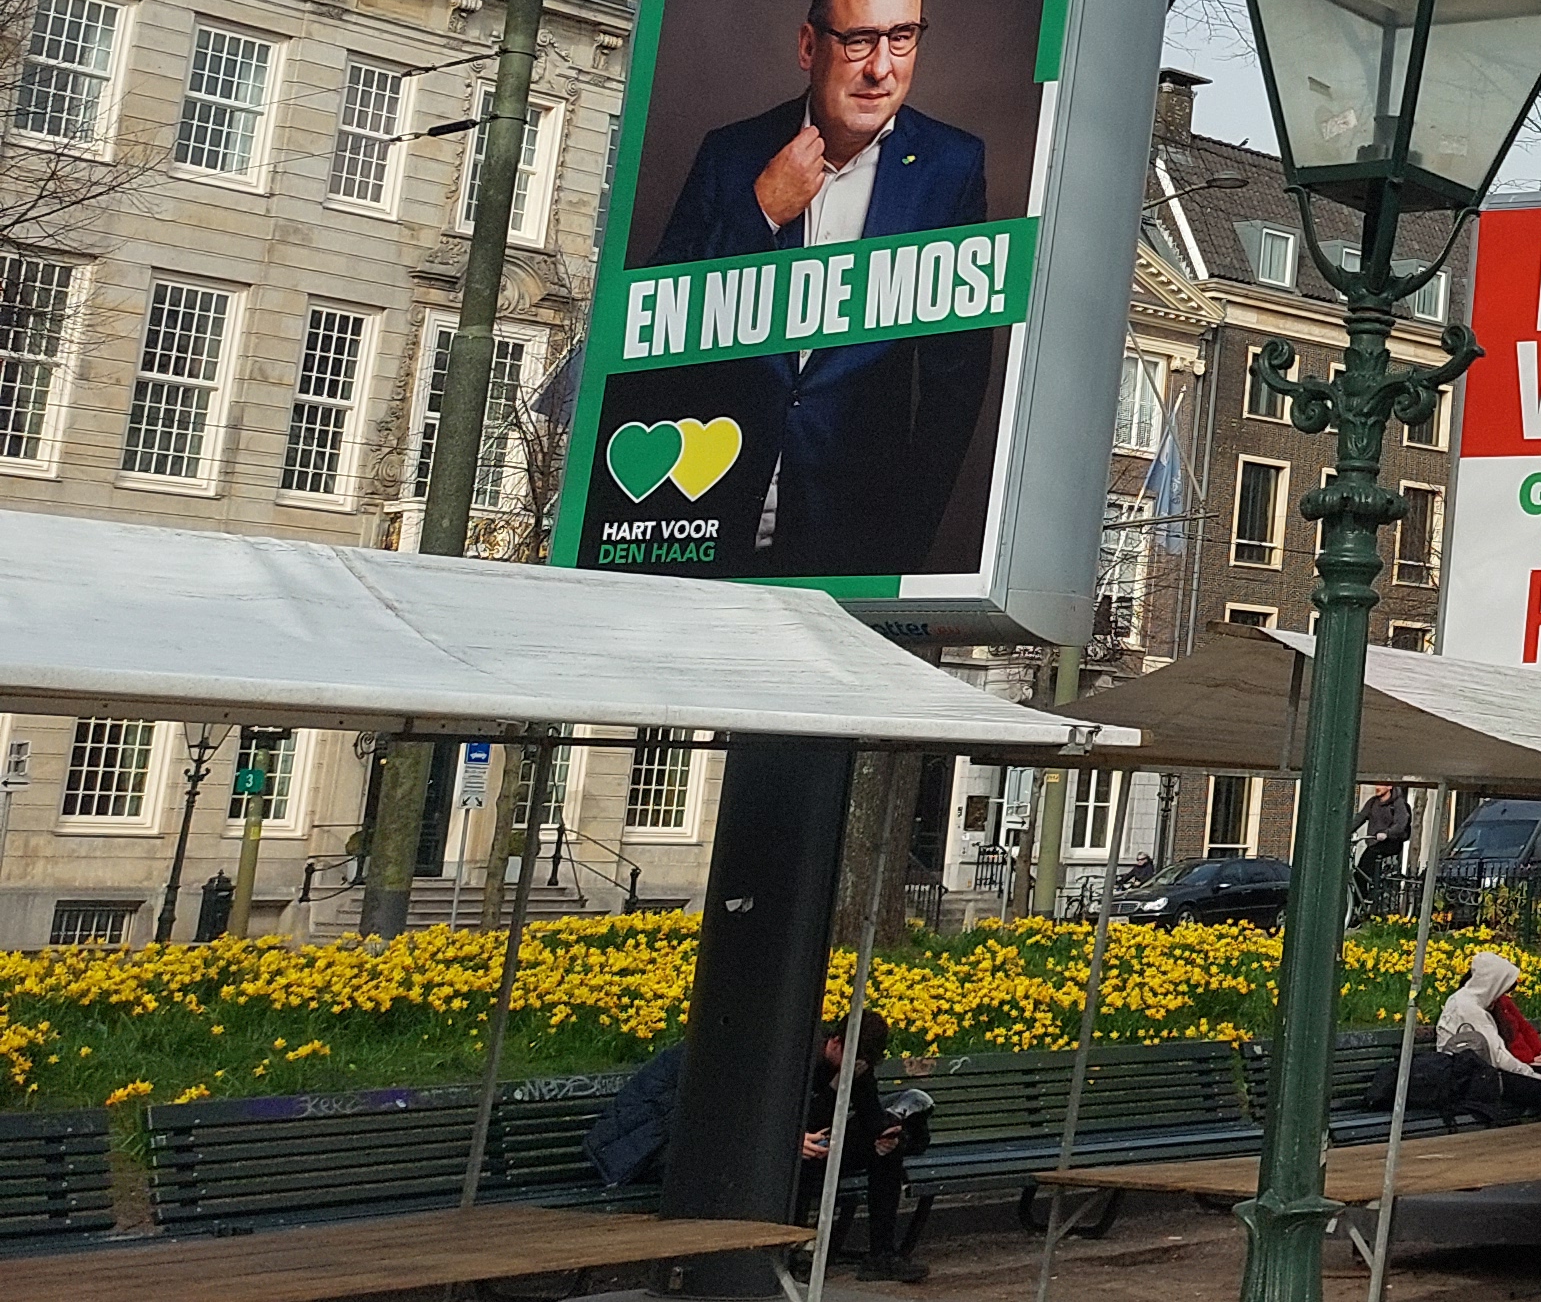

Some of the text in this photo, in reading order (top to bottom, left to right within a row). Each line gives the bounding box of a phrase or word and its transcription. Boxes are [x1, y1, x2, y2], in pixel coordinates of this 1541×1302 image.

[623, 233, 1010, 359] EN NU DE MOS!
[602, 519, 720, 541] HART VOOR
[598, 541, 716, 564] DEN HAAG
[245, 773, 254, 788] 3
